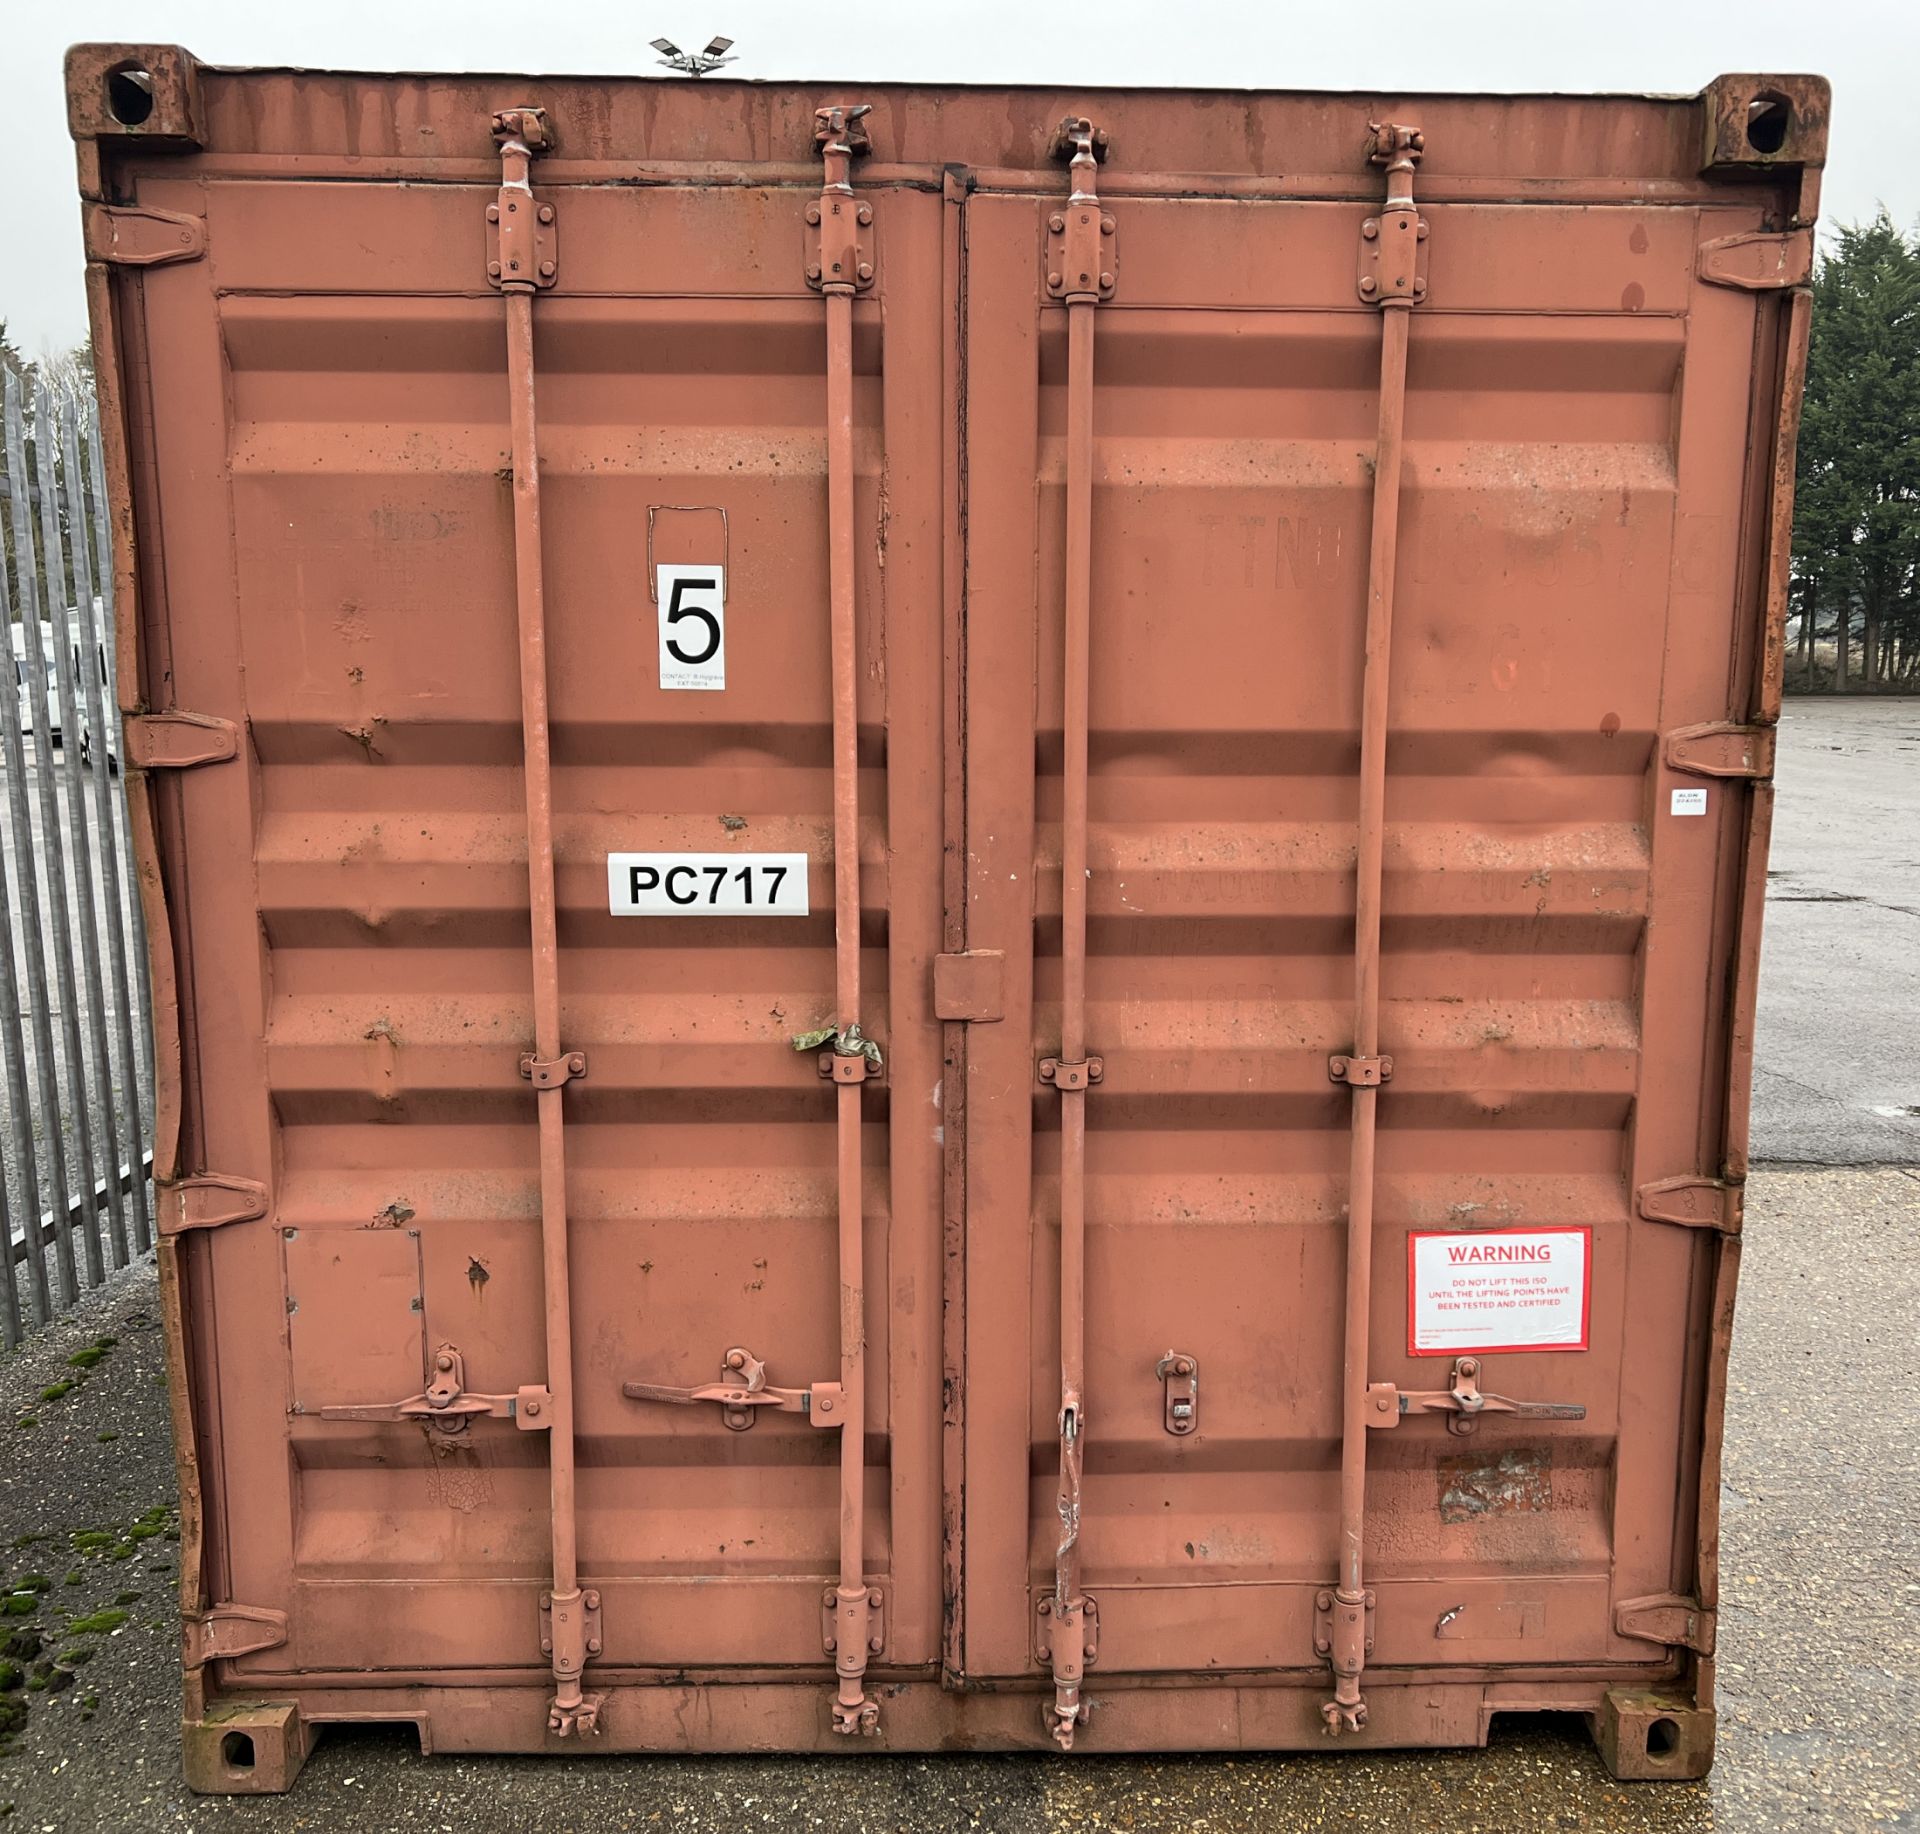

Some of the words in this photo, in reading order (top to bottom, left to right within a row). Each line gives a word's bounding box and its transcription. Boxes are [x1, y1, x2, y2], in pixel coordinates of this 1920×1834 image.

[666, 579, 721, 664] 5
[629, 866, 788, 905] PC717
[1448, 1245, 1551, 1262] WARNING
[1452, 1279, 1466, 1287] DO
[1468, 1279, 1487, 1287] NOT
[1489, 1278, 1507, 1286] LIFT
[1510, 1277, 1530, 1285] THIS
[1428, 1291, 1454, 1299] UNTIL
[1456, 1290, 1473, 1298] THE
[1476, 1289, 1510, 1297] LIFTING
[1513, 1288, 1545, 1296] POINTS
[1437, 1302, 1461, 1310] BEEN
[1463, 1301, 1495, 1309] TESTED
[1496, 1300, 1516, 1308] AND
[1518, 1299, 1561, 1307] CERTIFIED
